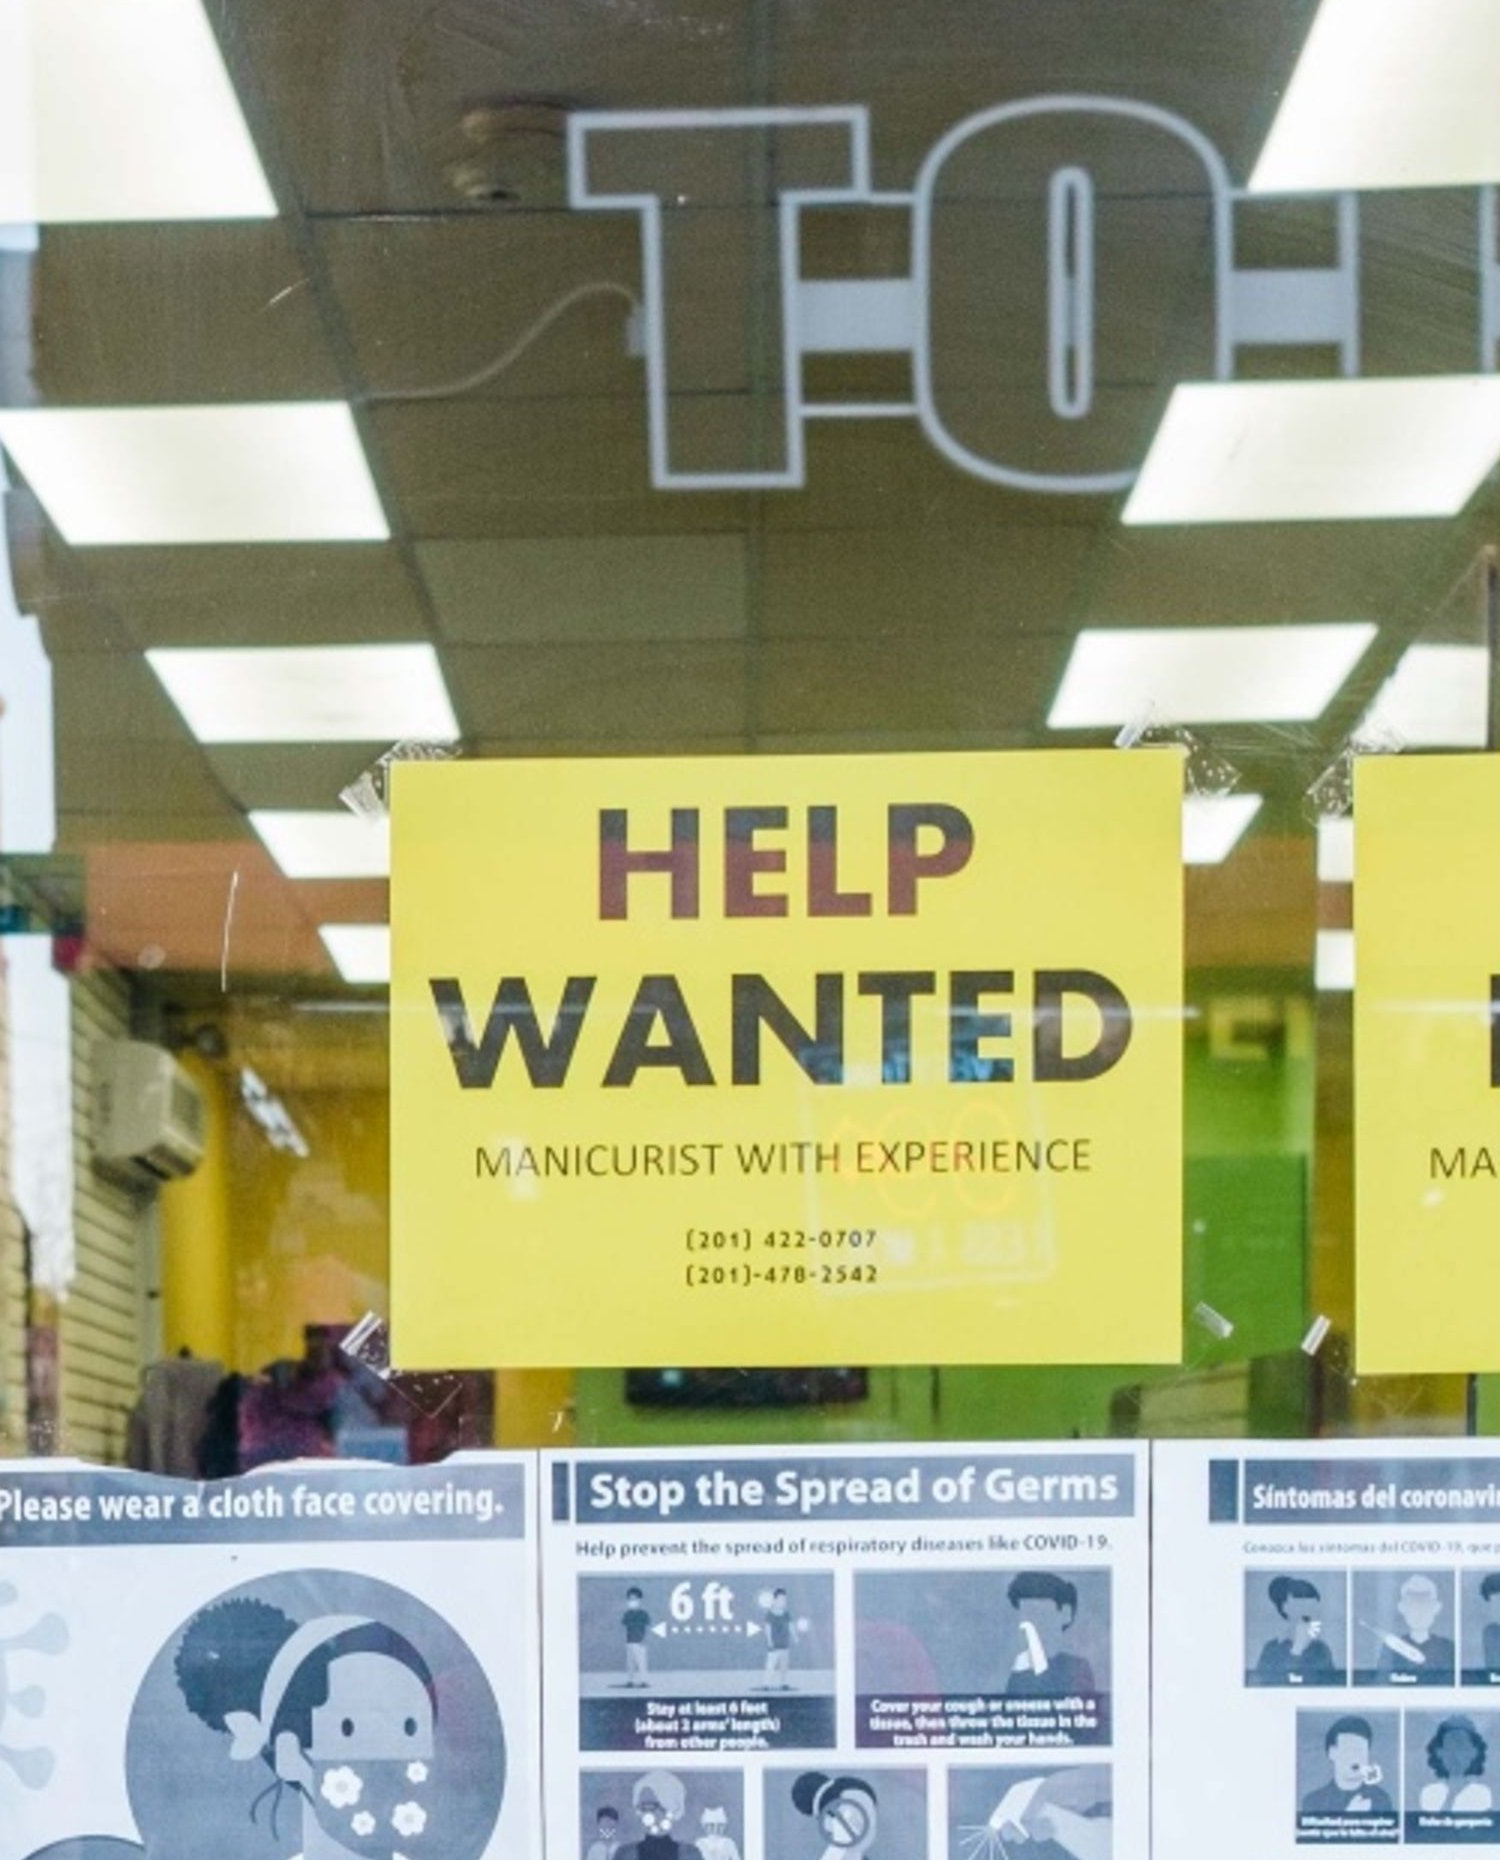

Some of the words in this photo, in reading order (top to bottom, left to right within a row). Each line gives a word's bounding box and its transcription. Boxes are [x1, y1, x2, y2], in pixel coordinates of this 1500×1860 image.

[598, 802, 976, 921] HELP
[429, 968, 1133, 1090] WANTED
[475, 1143, 723, 1179] MANICURIST
[738, 1141, 840, 1175] WITH
[858, 1139, 1092, 1174] EXPERIENCE
[686, 1228, 752, 1252] (201)
[763, 1227, 879, 1251] 422-0707
[686, 1263, 879, 1287] (201)-478-2542
[99, 1492, 176, 1521] wear
[182, 1492, 200, 1519] a
[208, 1486, 284, 1519] cloth
[292, 1484, 356, 1517] face
[364, 1482, 505, 1524] covering.
[590, 1473, 686, 1516] Stop
[694, 1470, 765, 1507] the
[775, 1468, 920, 1514] Spread
[932, 1465, 976, 1504] of
[985, 1468, 1118, 1503] Germs
[1253, 1482, 1356, 1510] Síntomas
[1361, 1482, 1397, 1508] del
[576, 1540, 616, 1558] Help
[620, 1541, 688, 1559] prevent
[692, 1539, 716, 1555] the
[725, 1538, 784, 1558] spread
[788, 1537, 806, 1553] of
[809, 1535, 905, 1555] respiratory
[911, 1535, 983, 1552] diseases
[989, 1534, 1020, 1551] like
[1022, 1533, 1114, 1551] COVID-19.
[670, 1581, 694, 1622] 6
[701, 1581, 735, 1621] ft
